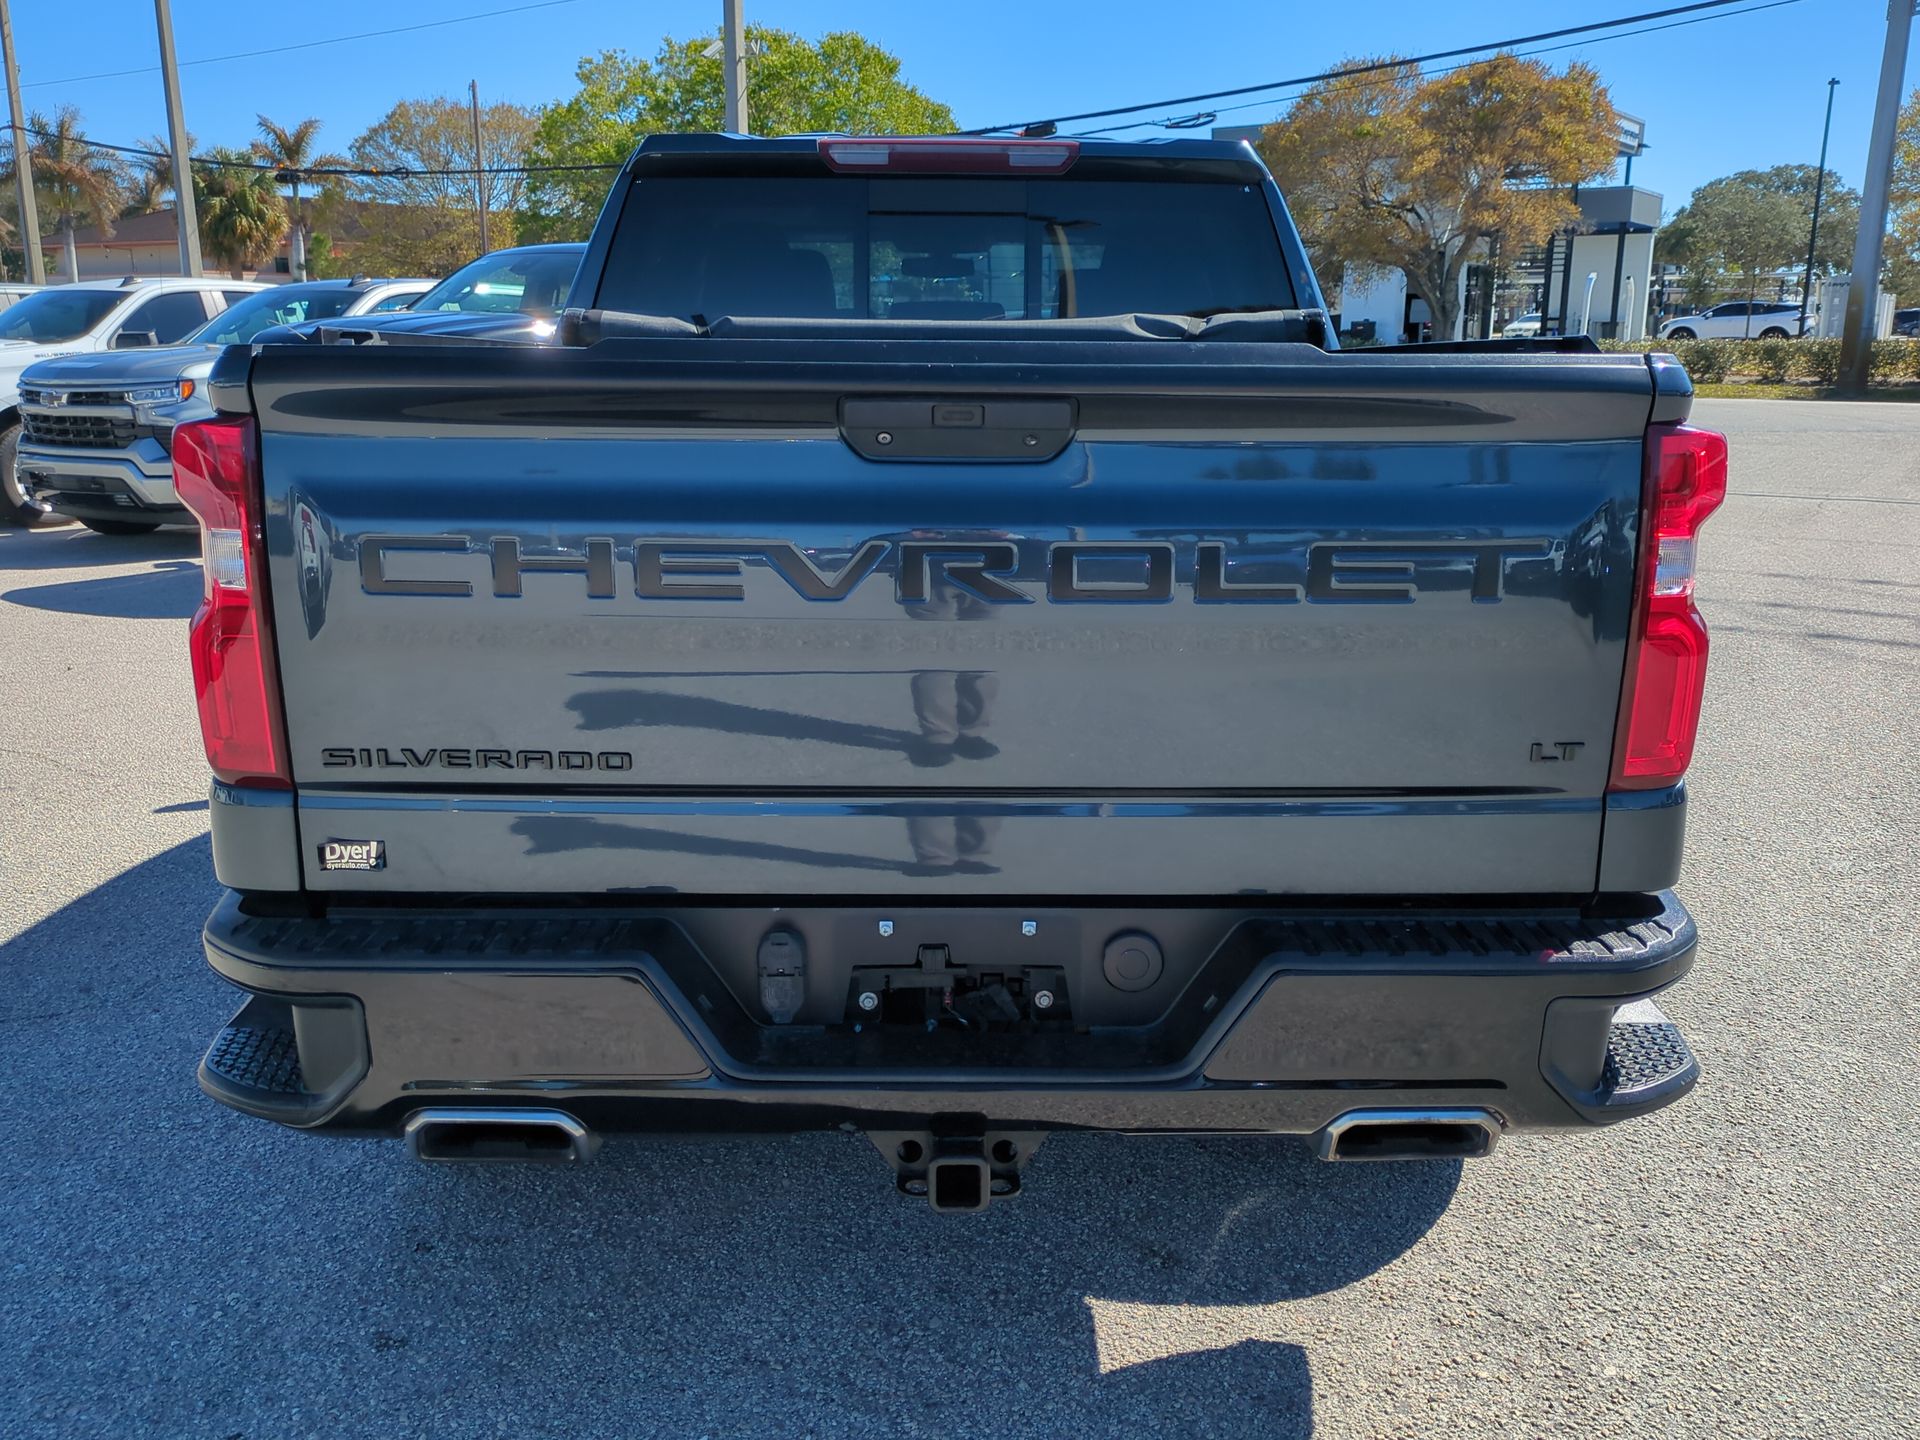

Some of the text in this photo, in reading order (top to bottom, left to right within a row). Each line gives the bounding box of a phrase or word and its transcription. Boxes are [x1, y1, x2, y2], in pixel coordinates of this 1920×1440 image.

[358, 535, 1551, 604] CHEVROLET
[321, 748, 633, 771] SILVERADO
[1529, 741, 1585, 761] LT
[325, 841, 377, 866] Dyer!
[326, 862, 370, 870] dyerauto.com
